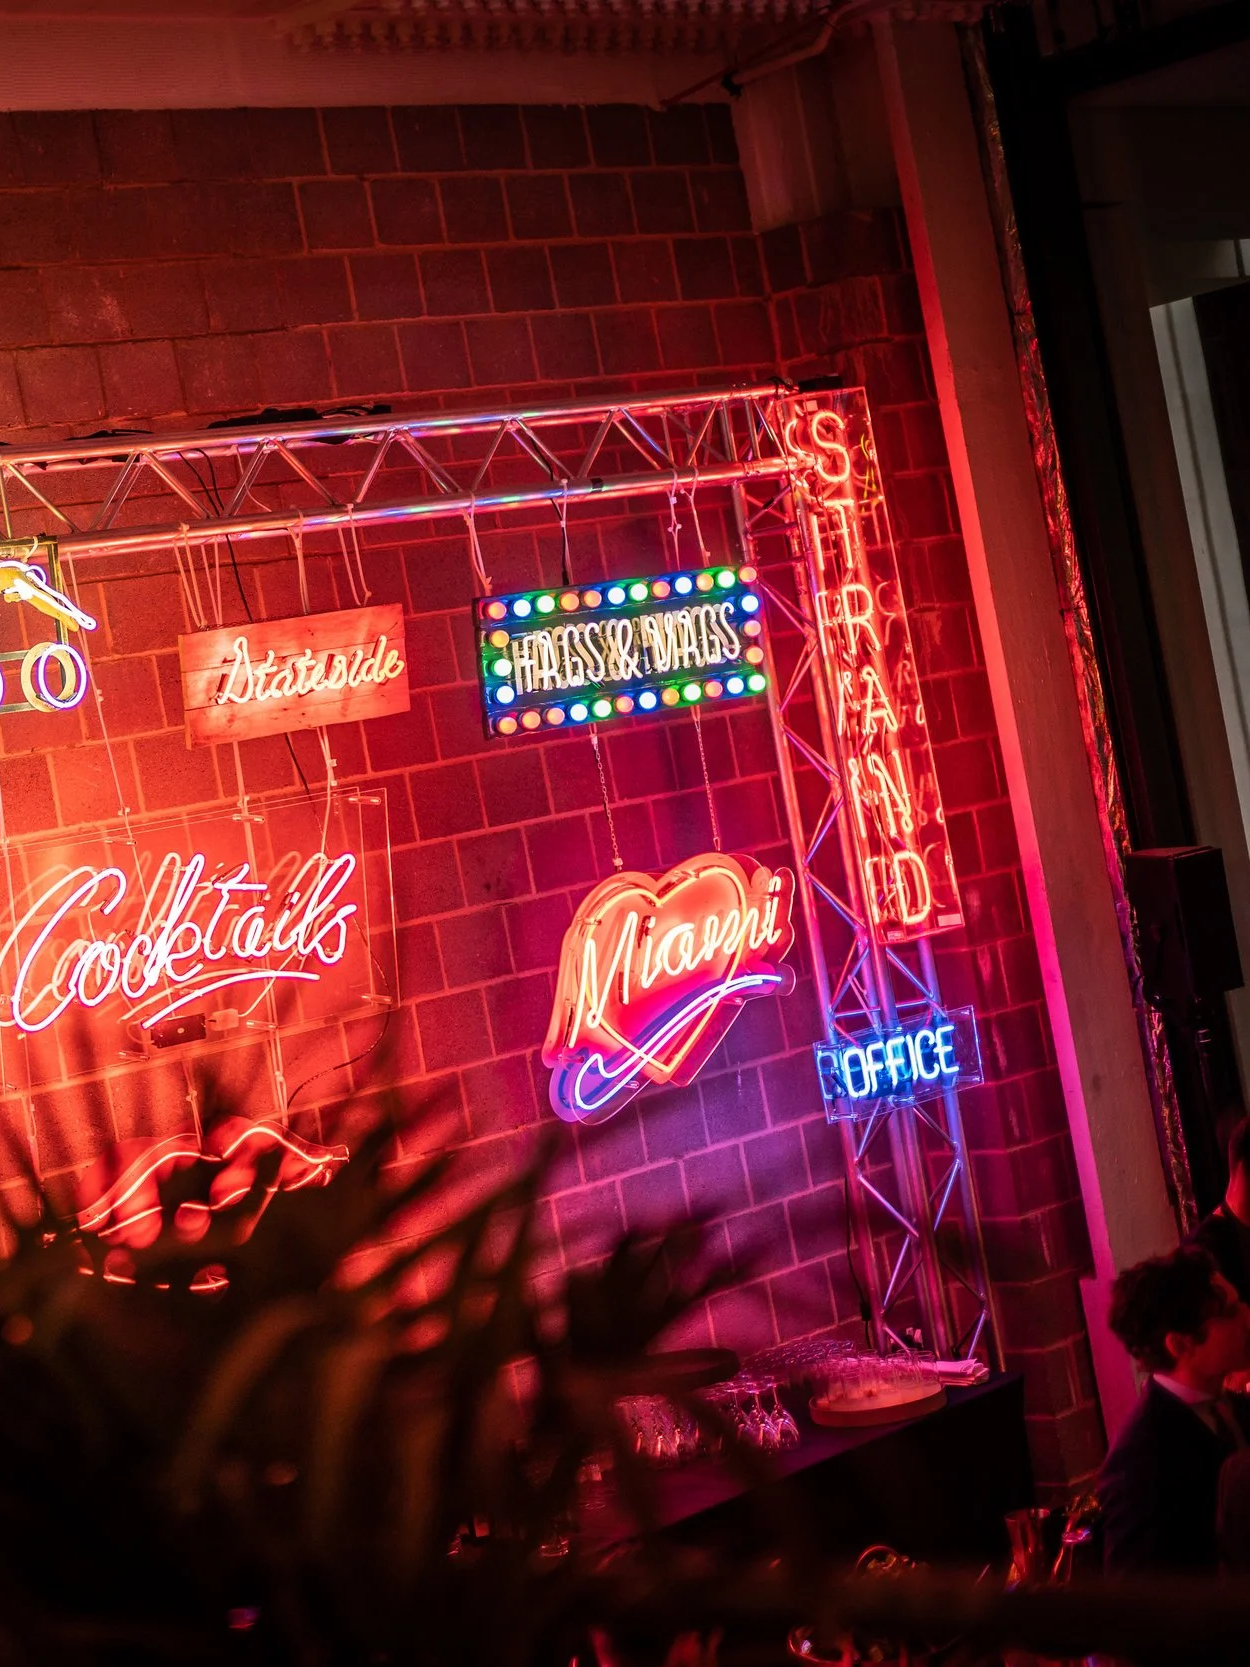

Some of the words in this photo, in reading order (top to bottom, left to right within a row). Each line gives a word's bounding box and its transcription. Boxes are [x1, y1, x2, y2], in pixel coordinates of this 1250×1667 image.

[216, 635, 405, 705] Stateside
[612, 618, 643, 681] &
[810, 410, 932, 926] STRAND
[10, 852, 357, 1033] Cocktails
[568, 875, 782, 1048] Miami
[842, 1024, 960, 1098] OFFICE
